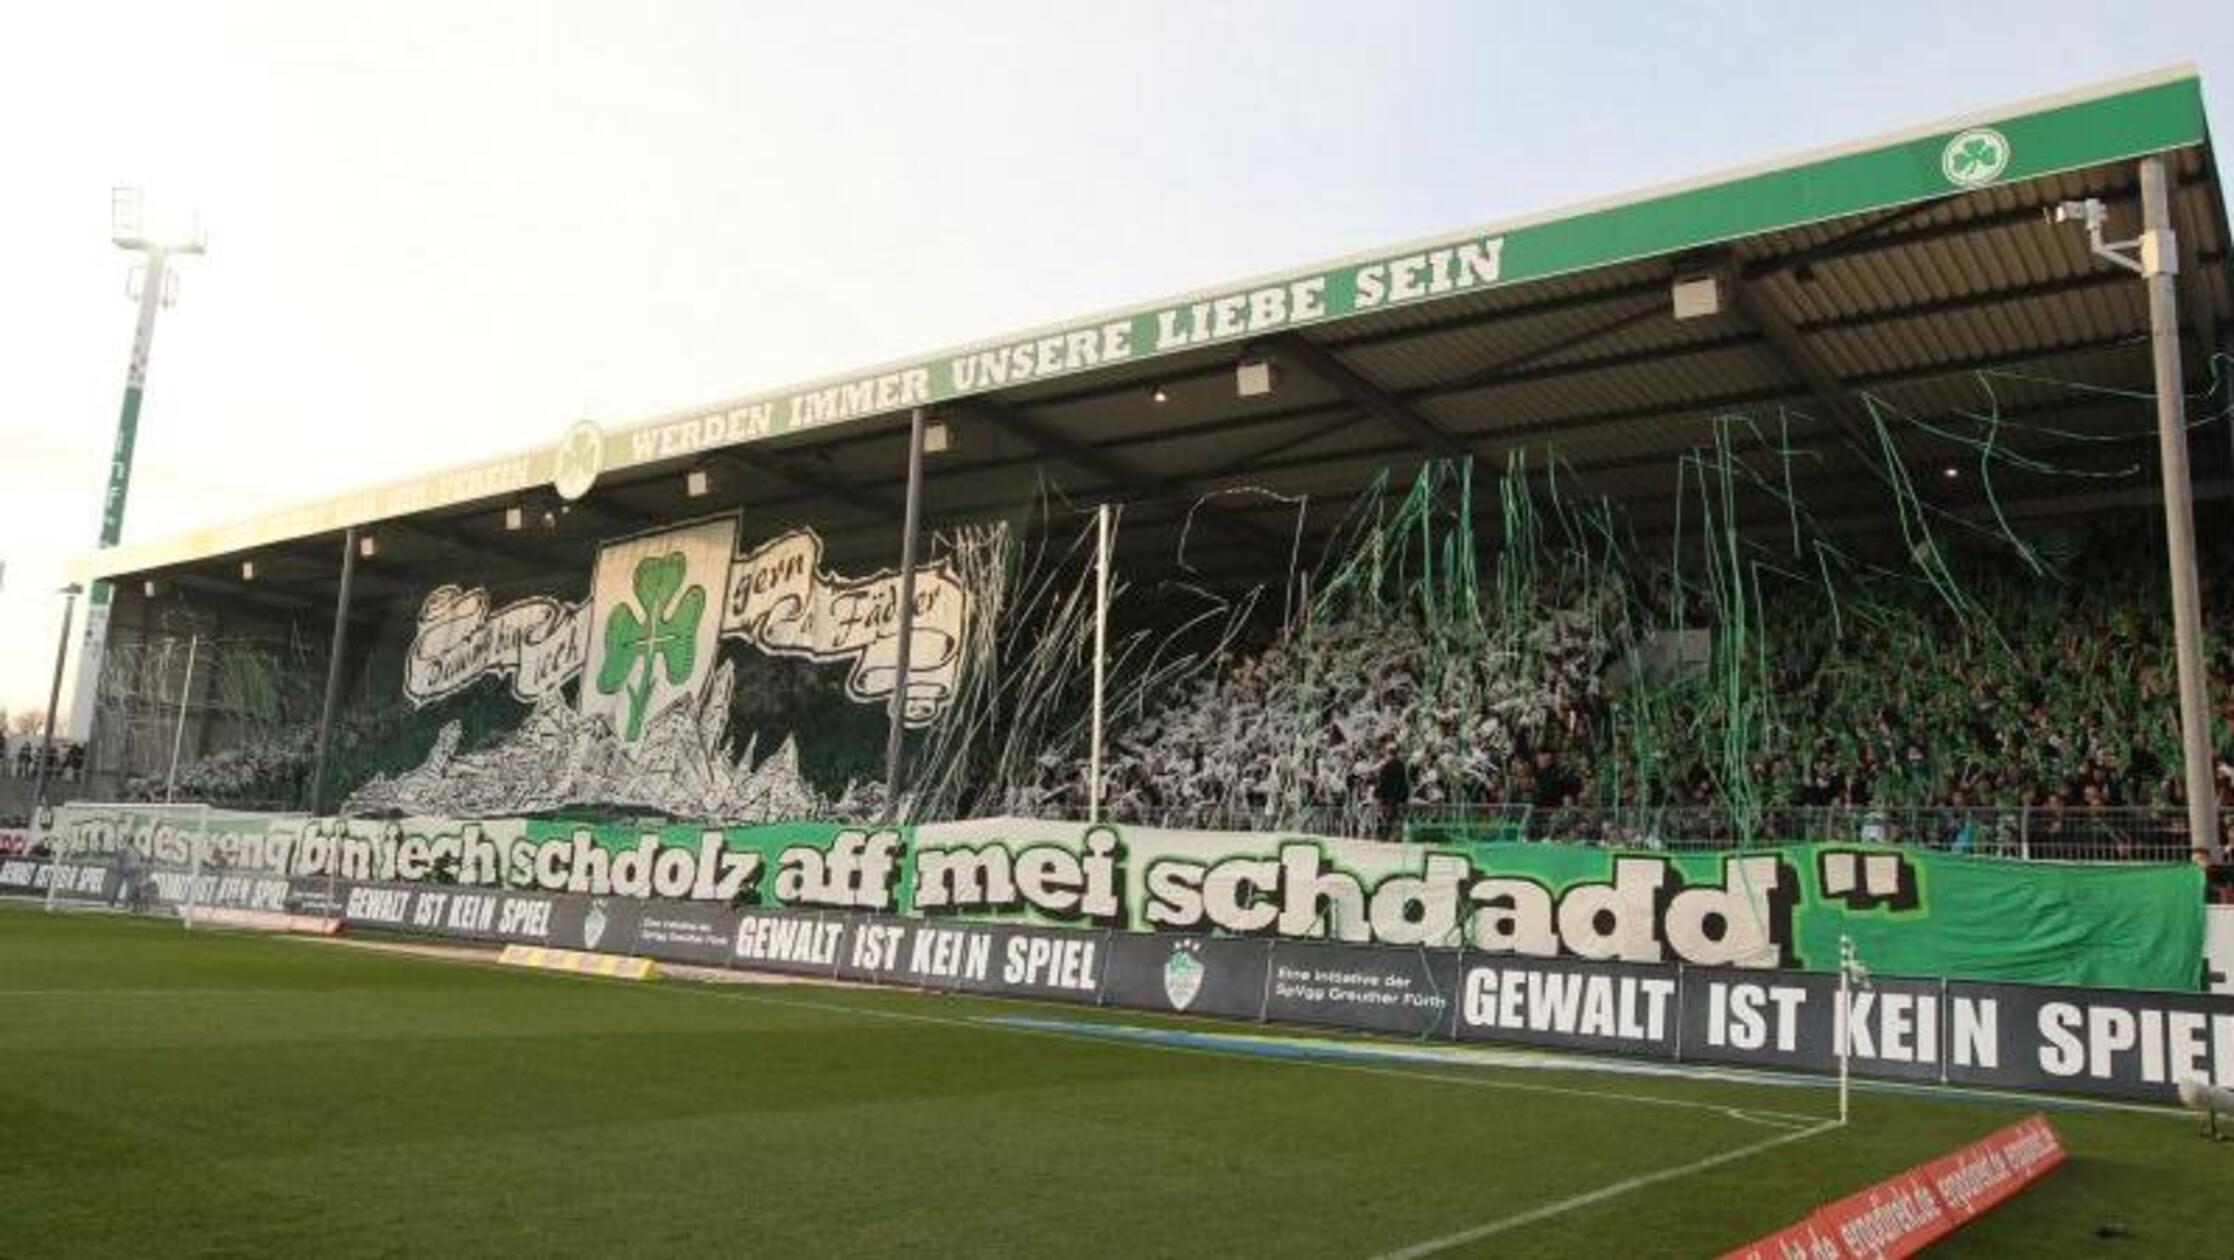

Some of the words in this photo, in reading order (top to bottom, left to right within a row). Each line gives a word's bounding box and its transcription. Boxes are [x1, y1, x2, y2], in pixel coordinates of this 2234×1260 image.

[631, 403, 774, 460] WERDEN
[789, 368, 929, 427] IMMER
[951, 321, 1131, 391] UNSERE
[1155, 276, 1326, 352] LIEBE
[1354, 237, 1504, 310] SEIN
[732, 553, 805, 616] gern
[831, 585, 941, 647] Fäder
[301, 822, 371, 880] bin
[379, 823, 498, 884] iech
[510, 829, 760, 900] schdolz
[775, 829, 899, 907] aff
[914, 826, 1118, 917] mei
[1146, 843, 1782, 968] schdadd
[347, 887, 411, 921] GEWALT
[414, 892, 447, 926] IST
[448, 894, 496, 931] KEIN
[499, 898, 552, 936] SPIEL
[735, 916, 843, 964] GEWALT
[852, 923, 905, 971] IST
[910, 927, 992, 981] KEIN
[1003, 935, 1097, 990] SPIEL
[1278, 966, 1311, 981] Eine
[1384, 974, 1412, 988] der
[1463, 966, 1675, 1041] GEWALT
[1707, 981, 1806, 1051] IST
[1833, 988, 1998, 1068] KEIN
